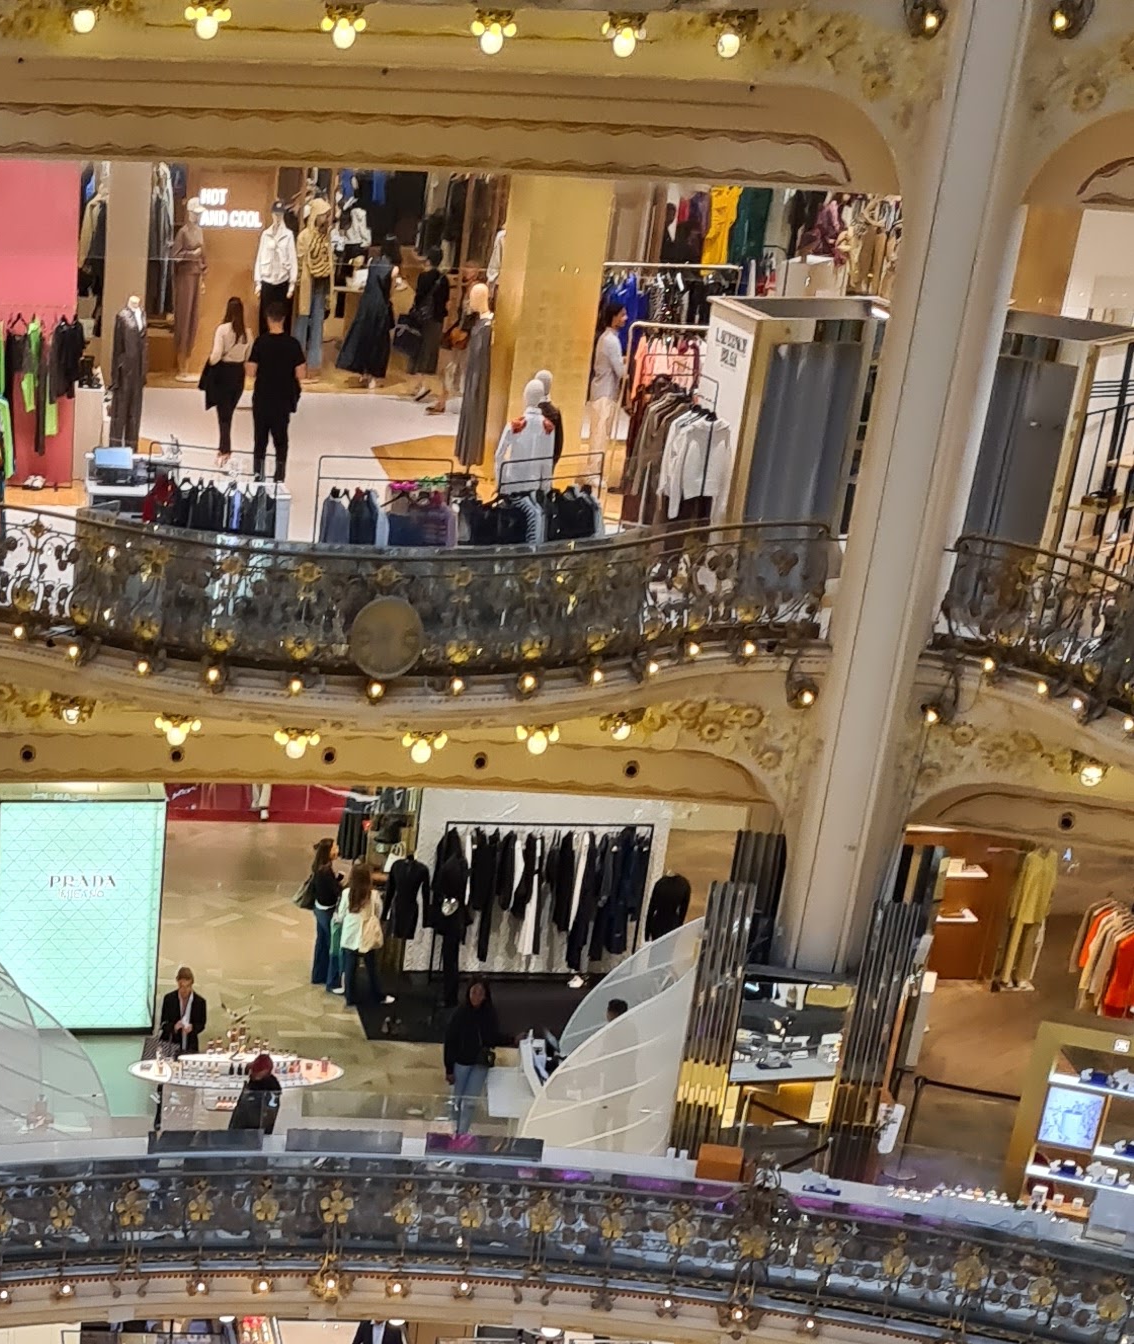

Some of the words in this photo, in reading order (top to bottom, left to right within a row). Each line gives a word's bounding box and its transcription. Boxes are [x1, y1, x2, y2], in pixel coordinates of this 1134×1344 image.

[200, 188, 229, 206] HOT
[199, 209, 228, 226] AND
[229, 209, 262, 228] COOL
[50, 875, 116, 887] PRADA
